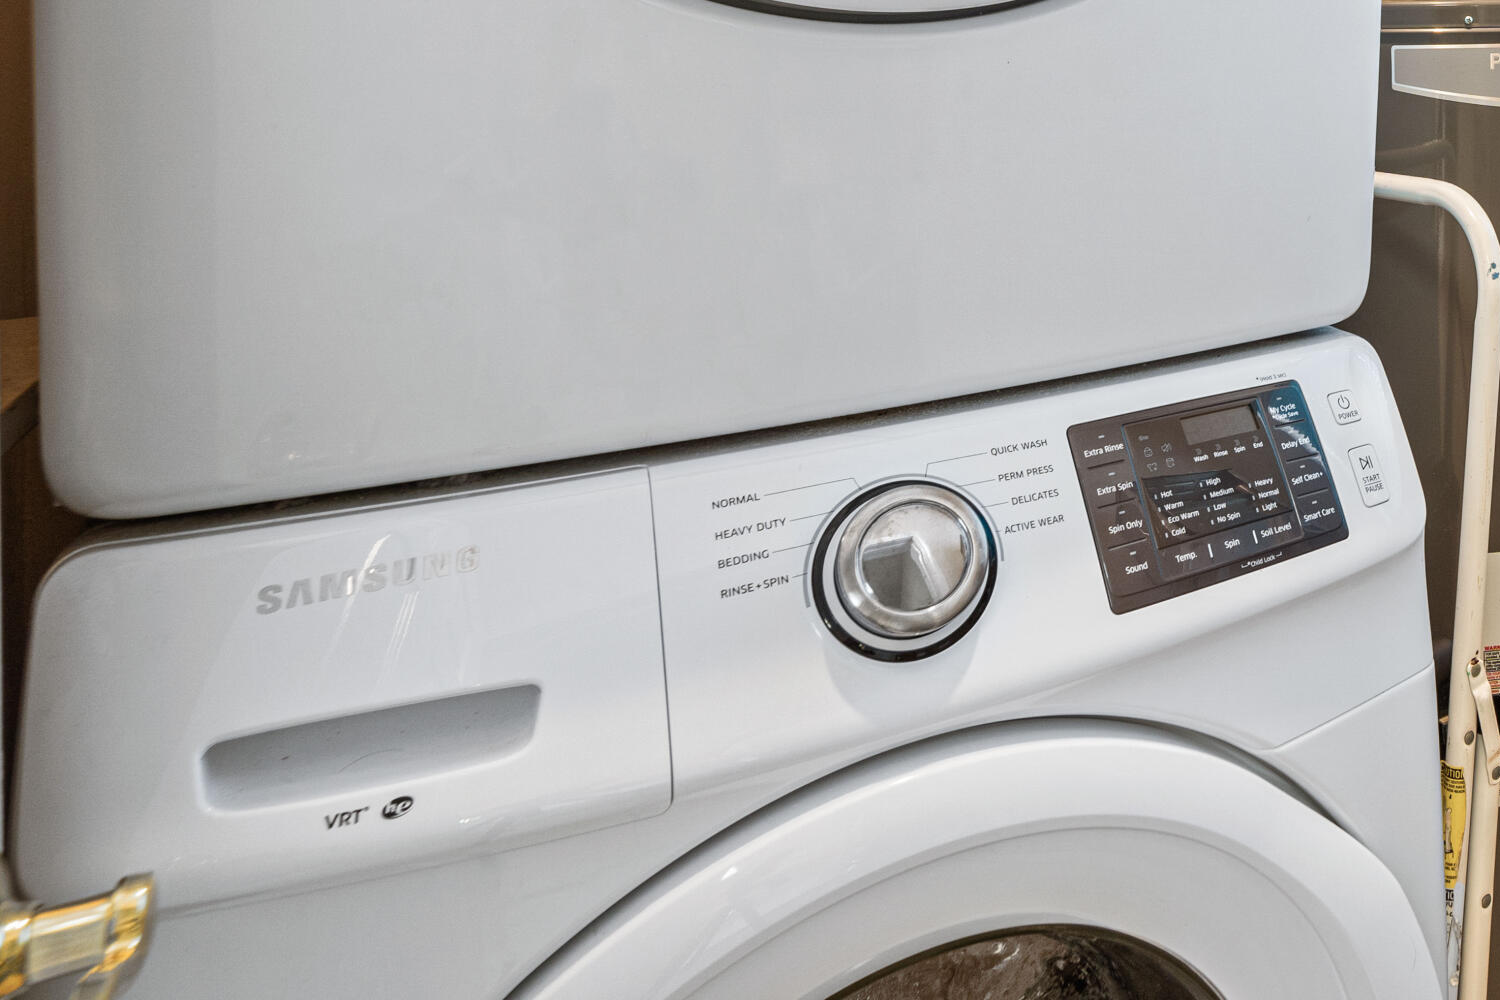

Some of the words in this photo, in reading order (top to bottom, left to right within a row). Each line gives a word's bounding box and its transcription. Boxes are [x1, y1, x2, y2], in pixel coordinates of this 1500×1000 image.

[1280, 403, 1297, 412] Cycle
[1338, 410, 1360, 420] POWER
[991, 444, 1020, 456] QUICK
[1020, 438, 1048, 450] WASH
[1281, 440, 1299, 451] Delay
[1298, 436, 1311, 446] End
[1083, 447, 1105, 458] Extra
[1104, 443, 1125, 453] Rinse
[1193, 454, 1209, 462] Wash
[1213, 450, 1229, 458] Rinse
[1233, 445, 1247, 453] Spin
[1253, 441, 1264, 449] End
[998, 470, 1025, 482] PERM
[1026, 464, 1055, 477] PRESS
[1362, 473, 1381, 484] START
[1205, 477, 1222, 487] High
[1254, 477, 1274, 488] Heavy
[1291, 476, 1304, 486] Self
[1096, 486, 1117, 496] Extra
[1117, 481, 1134, 491] Spin
[1160, 490, 1173, 499] Hot
[1209, 487, 1235, 499] Medium
[1258, 488, 1280, 499] Normal
[1365, 483, 1385, 494] PAUSE
[711, 493, 761, 510] NORMAL
[1011, 489, 1060, 506] DELICATES
[1164, 500, 1184, 511] Warm
[1213, 502, 1227, 511] Low
[1261, 502, 1278, 512] Light
[1168, 515, 1180, 524] Eco
[1180, 509, 1200, 520] Warm
[1217, 515, 1227, 524] No
[1227, 511, 1241, 521] Spin
[1304, 511, 1322, 522] Smart
[1321, 506, 1336, 517] Care
[715, 525, 753, 541] HEAVY
[757, 518, 787, 532] DUTY
[1004, 520, 1036, 534] ACTIVE
[1038, 514, 1065, 528] WEAR
[1108, 524, 1126, 535] Spin
[1126, 519, 1143, 530] Only
[1260, 527, 1274, 538] Soil
[1274, 522, 1292, 534] Level
[1171, 526, 1187, 537] Cold
[1224, 538, 1241, 550] Spin
[717, 550, 770, 569] BEDDING
[1175, 551, 1198, 563] Temp.
[1264, 553, 1276, 563] Lock
[1125, 561, 1149, 575] Sound
[256, 545, 480, 615] SAMSUNG
